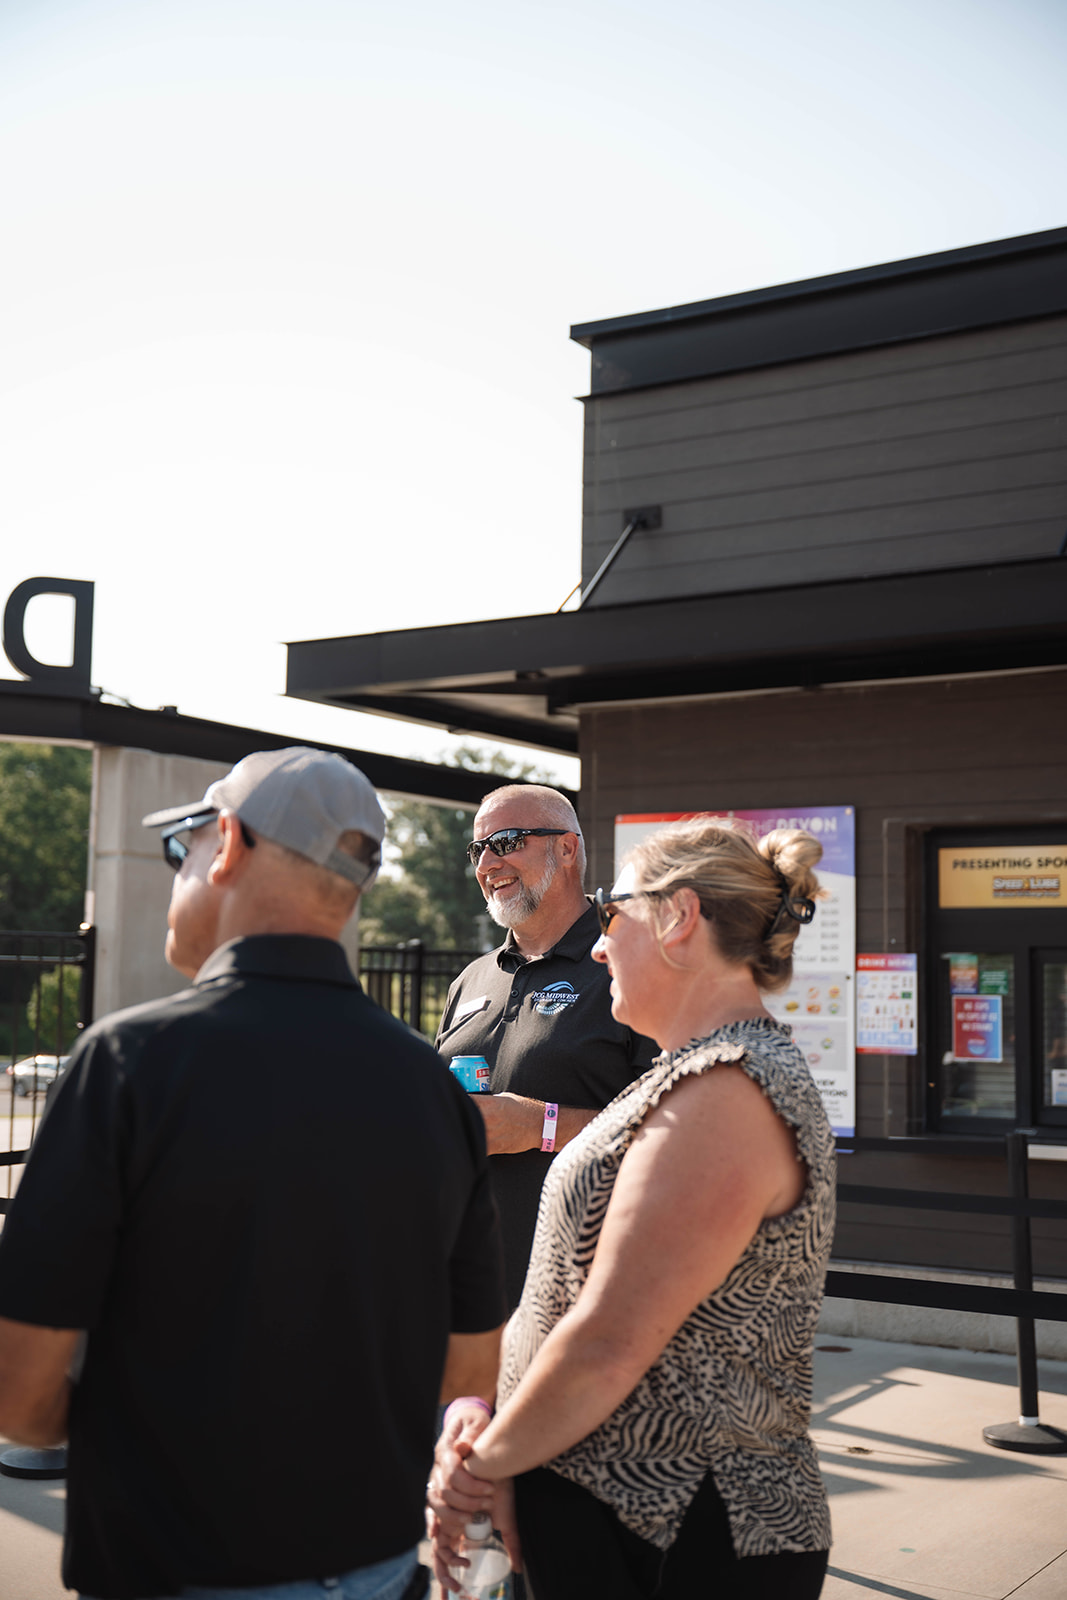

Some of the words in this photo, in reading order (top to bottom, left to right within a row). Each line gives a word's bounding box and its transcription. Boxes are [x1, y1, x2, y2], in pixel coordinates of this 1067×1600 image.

[776, 816, 838, 833] DEVON
[952, 857, 1033, 871] PRESENTING
[546, 992, 580, 1000] MIDWEST
